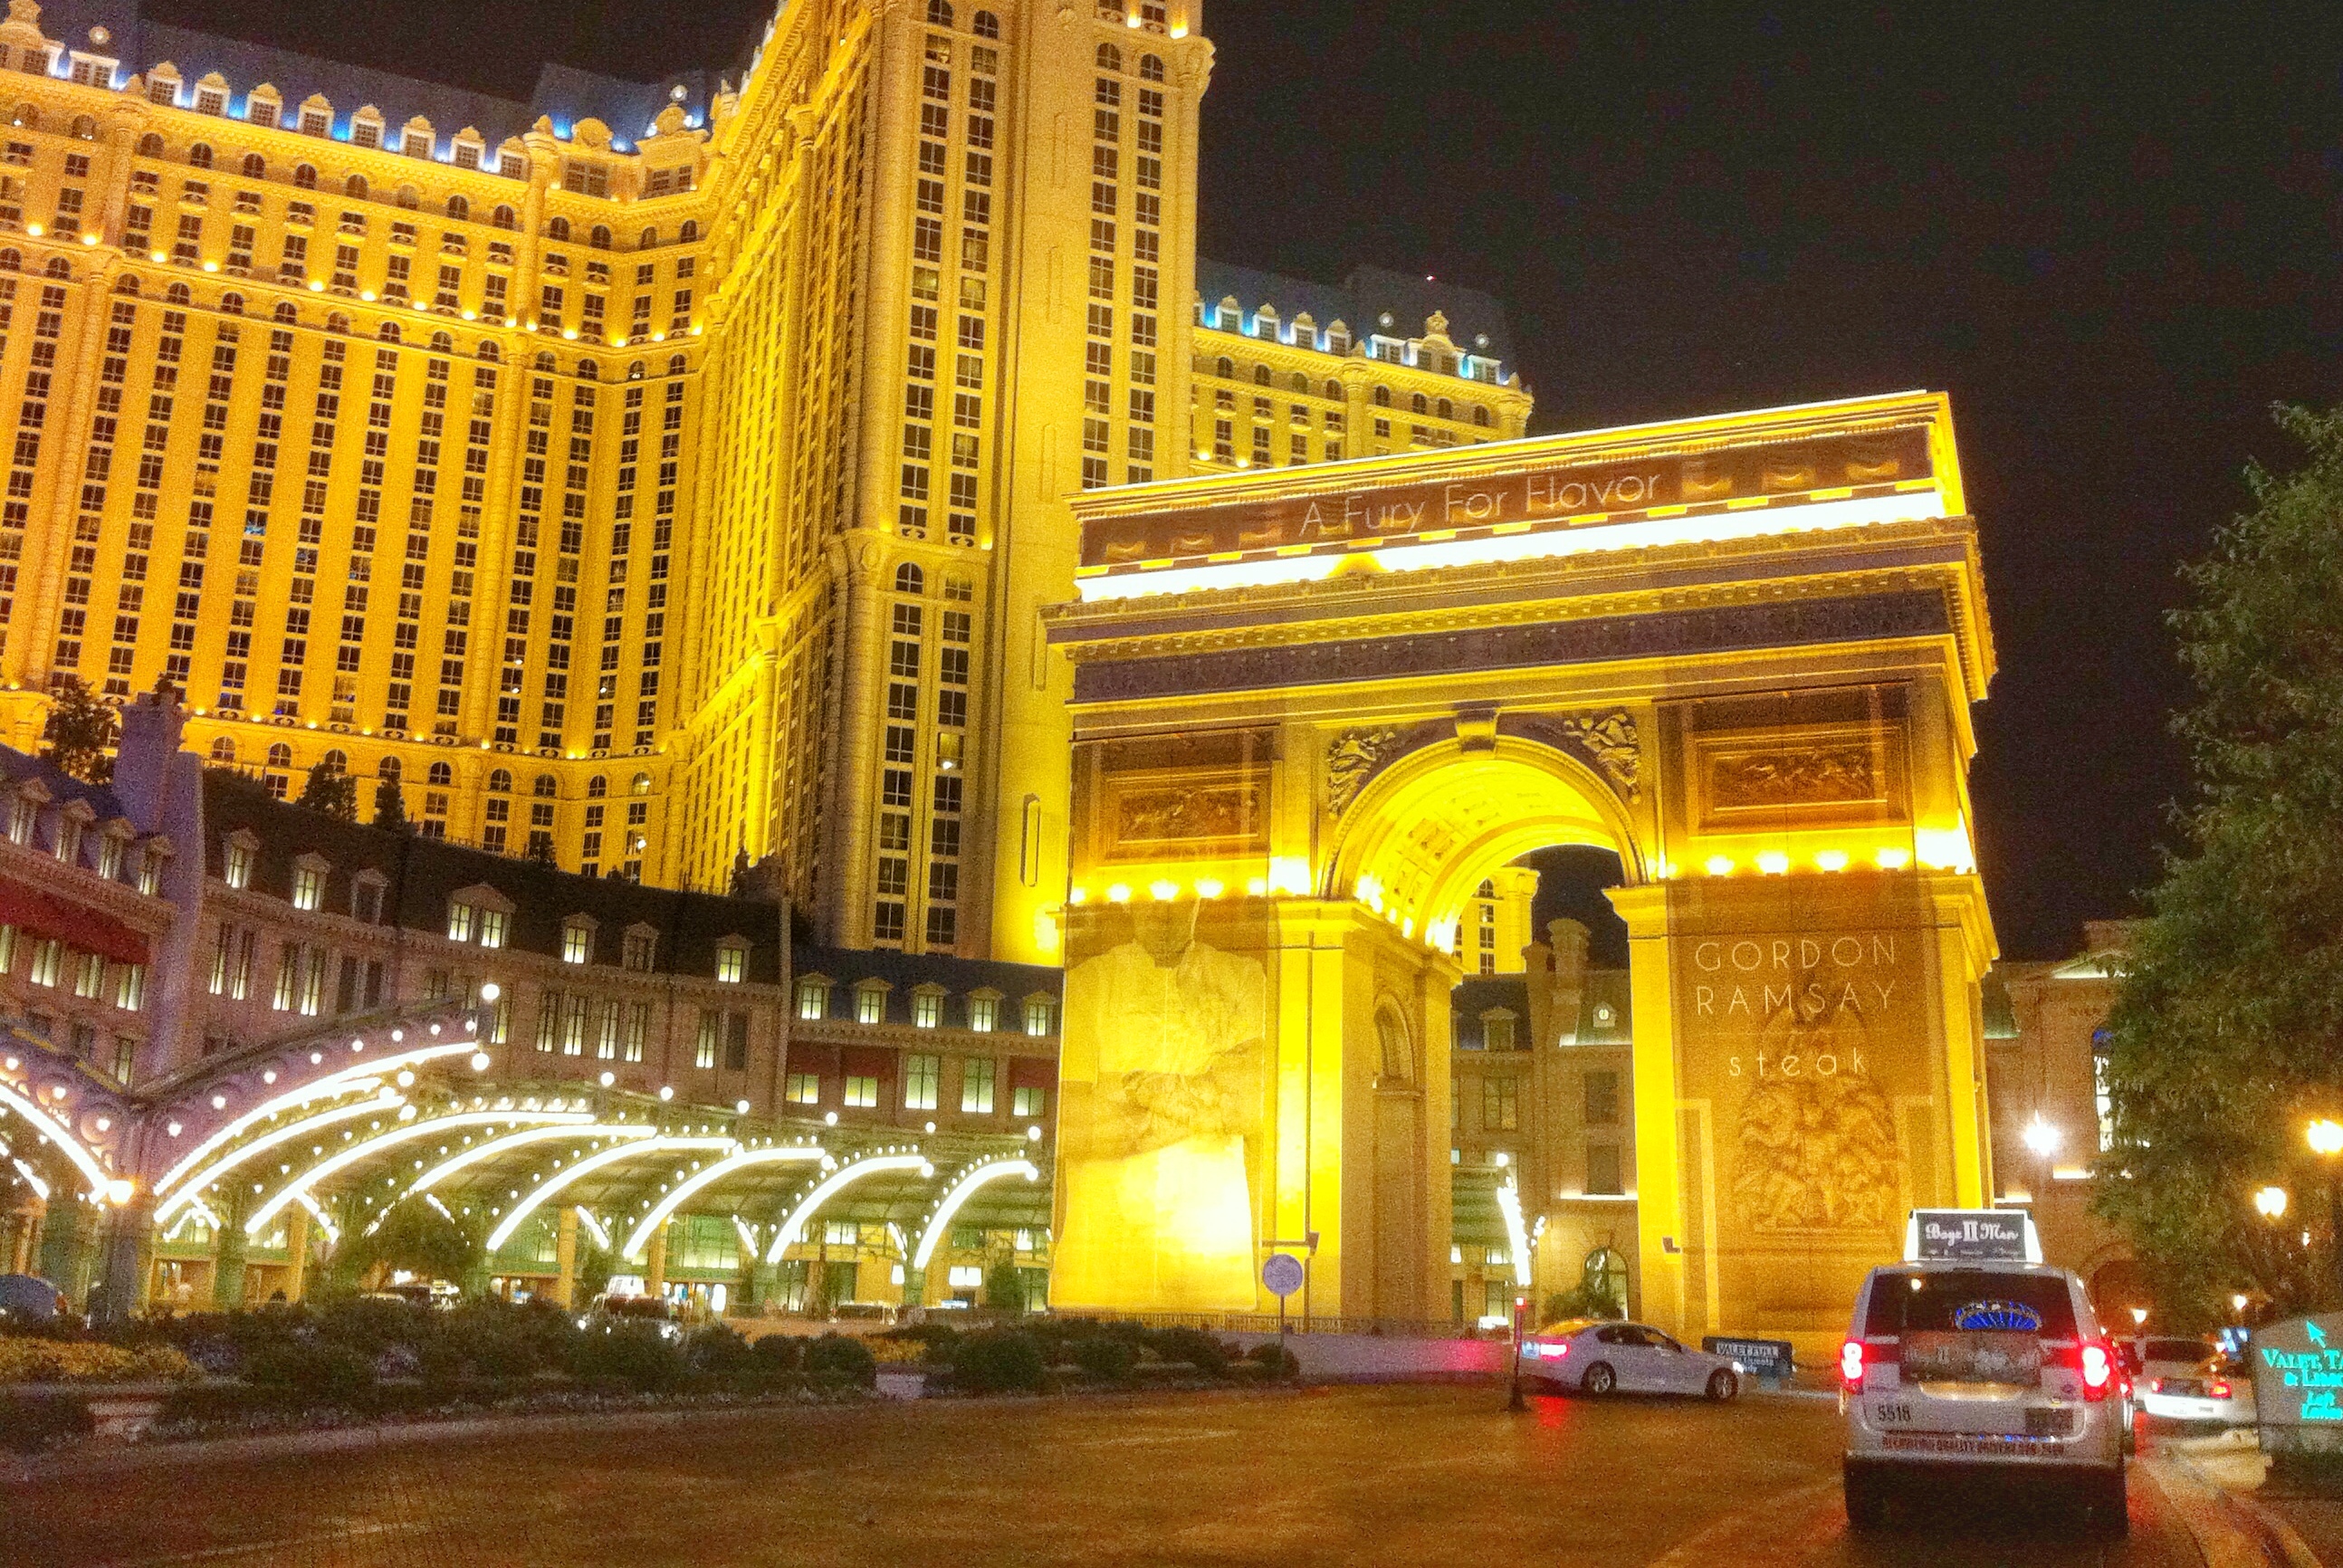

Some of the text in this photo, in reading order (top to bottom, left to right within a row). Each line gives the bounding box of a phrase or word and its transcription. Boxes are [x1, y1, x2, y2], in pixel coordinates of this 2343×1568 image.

[1298, 473, 1661, 537] A Fury For Flavor
[1695, 935, 1896, 972] GORDON
[1697, 980, 1897, 1017] RAMSAY
[1728, 1047, 1868, 1076] steak
[1963, 1220, 1979, 1242] II
[1980, 1223, 2019, 1240] Men
